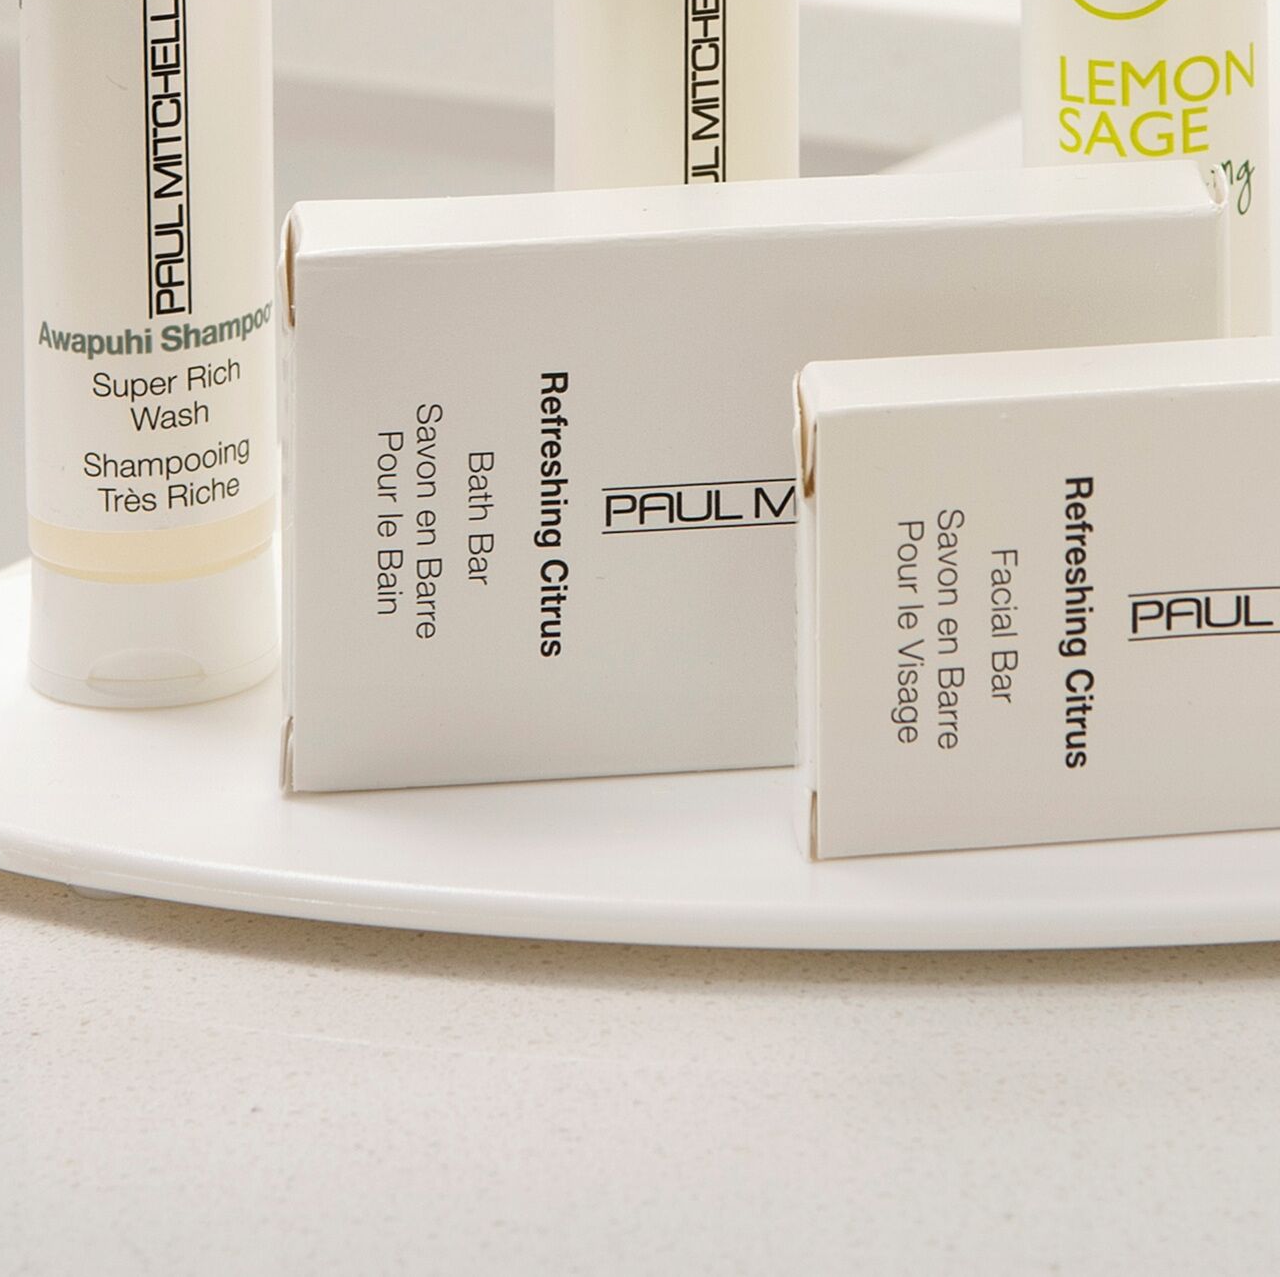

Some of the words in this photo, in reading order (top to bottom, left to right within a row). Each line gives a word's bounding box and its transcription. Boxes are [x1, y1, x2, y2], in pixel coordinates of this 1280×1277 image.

[1059, 41, 1254, 107] LEMON
[1058, 106, 1209, 158] SAGE
[154, 204, 185, 315] PAUL
[39, 321, 153, 360] Awapuhi
[160, 302, 271, 352] Shampoo
[93, 372, 177, 402] Super
[188, 359, 240, 391] Rich
[130, 400, 209, 431] Wash
[83, 438, 250, 480] Shampooing
[377, 432, 403, 502] Pour
[416, 404, 443, 498] Savon
[534, 372, 568, 547] Refreshing
[97, 488, 157, 512] Très
[168, 476, 240, 509] Riche
[468, 452, 494, 520] Bath
[605, 489, 743, 526] PAUL
[377, 514, 403, 537] le
[416, 510, 436, 545] en
[897, 521, 924, 593] Pour
[937, 510, 965, 605] Savon
[377, 550, 403, 614] Bain
[468, 534, 494, 585] Bar
[1058, 477, 1094, 657] Refreshing
[416, 558, 442, 639] Barre
[540, 559, 569, 657] Citrus
[898, 605, 924, 629] le
[991, 550, 1018, 637] Facial
[1132, 594, 1274, 633] PAUL
[938, 618, 958, 654] en
[891, 639, 924, 743] Visage
[938, 667, 965, 749] Barre
[991, 650, 1018, 703] Bar
[1065, 669, 1094, 769] Citrus
